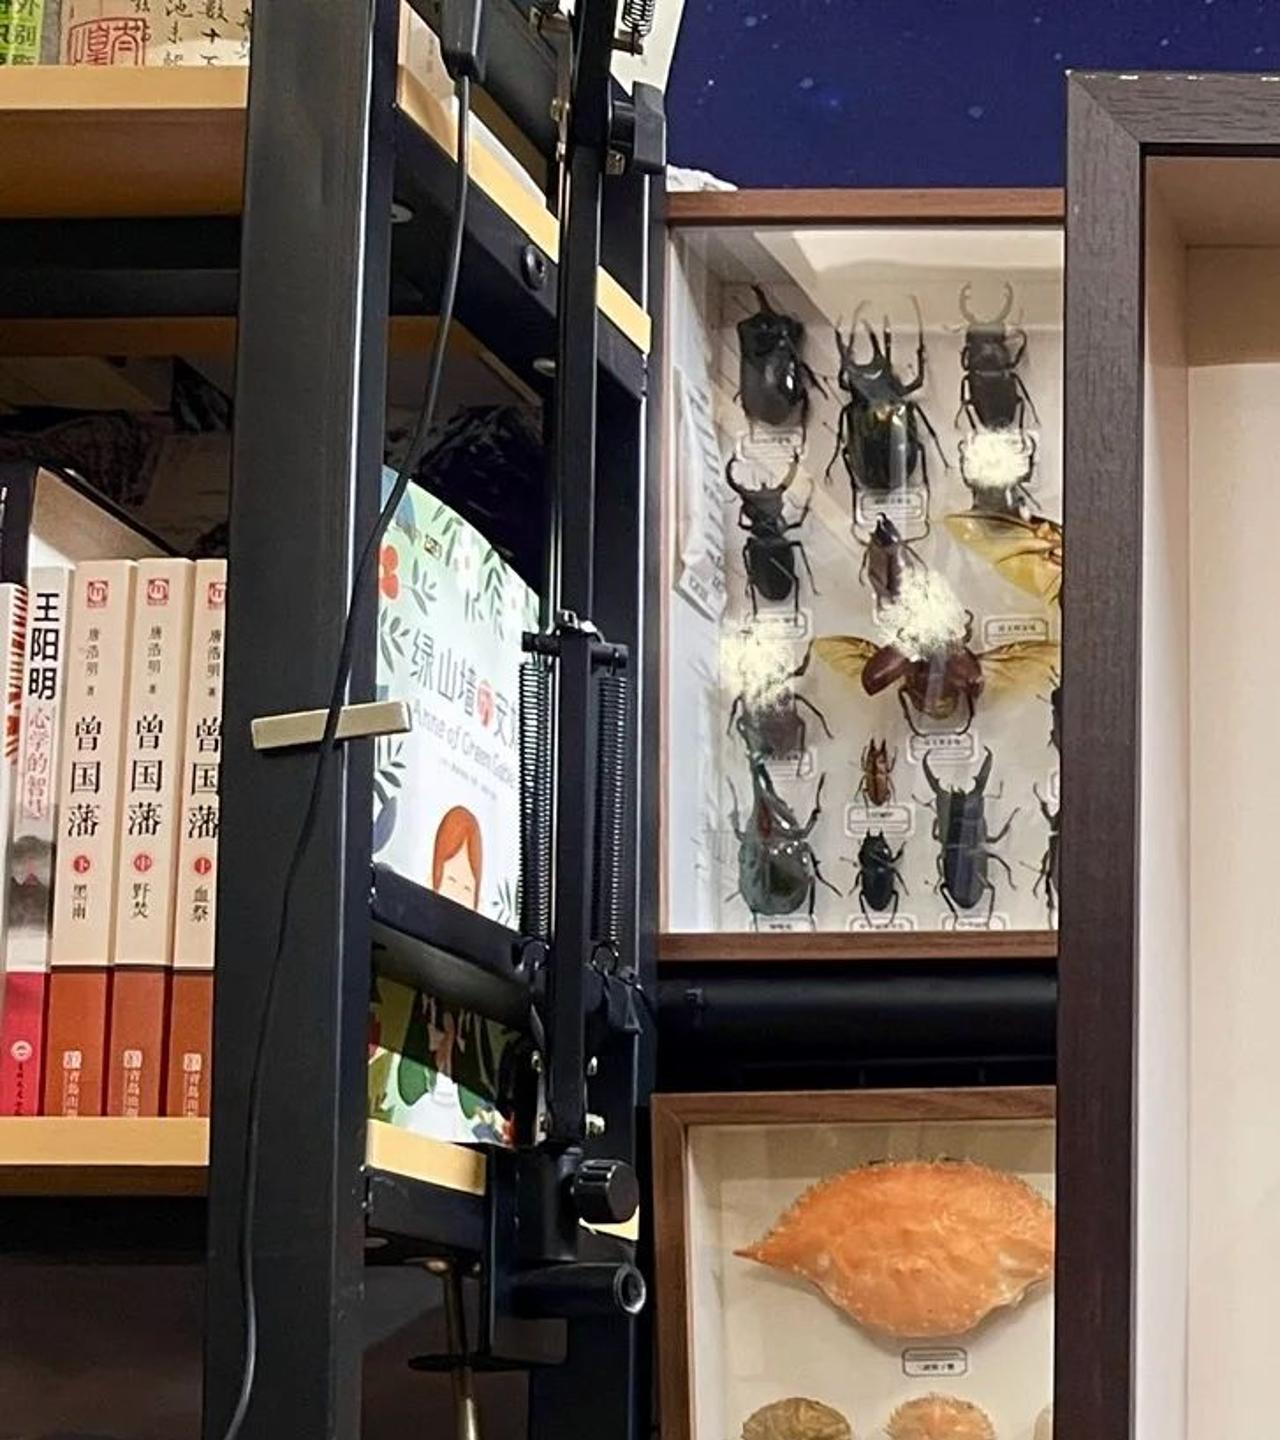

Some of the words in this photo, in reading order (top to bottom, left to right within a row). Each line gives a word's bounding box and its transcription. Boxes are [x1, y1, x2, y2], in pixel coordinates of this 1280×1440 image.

[28, 592, 60, 700] 王阳明
[146, 625, 162, 675] 唐浩明
[68, 714, 102, 837] 曾国藩
[128, 713, 163, 836] 曾国藩
[188, 716, 221, 839] 曾国藩
